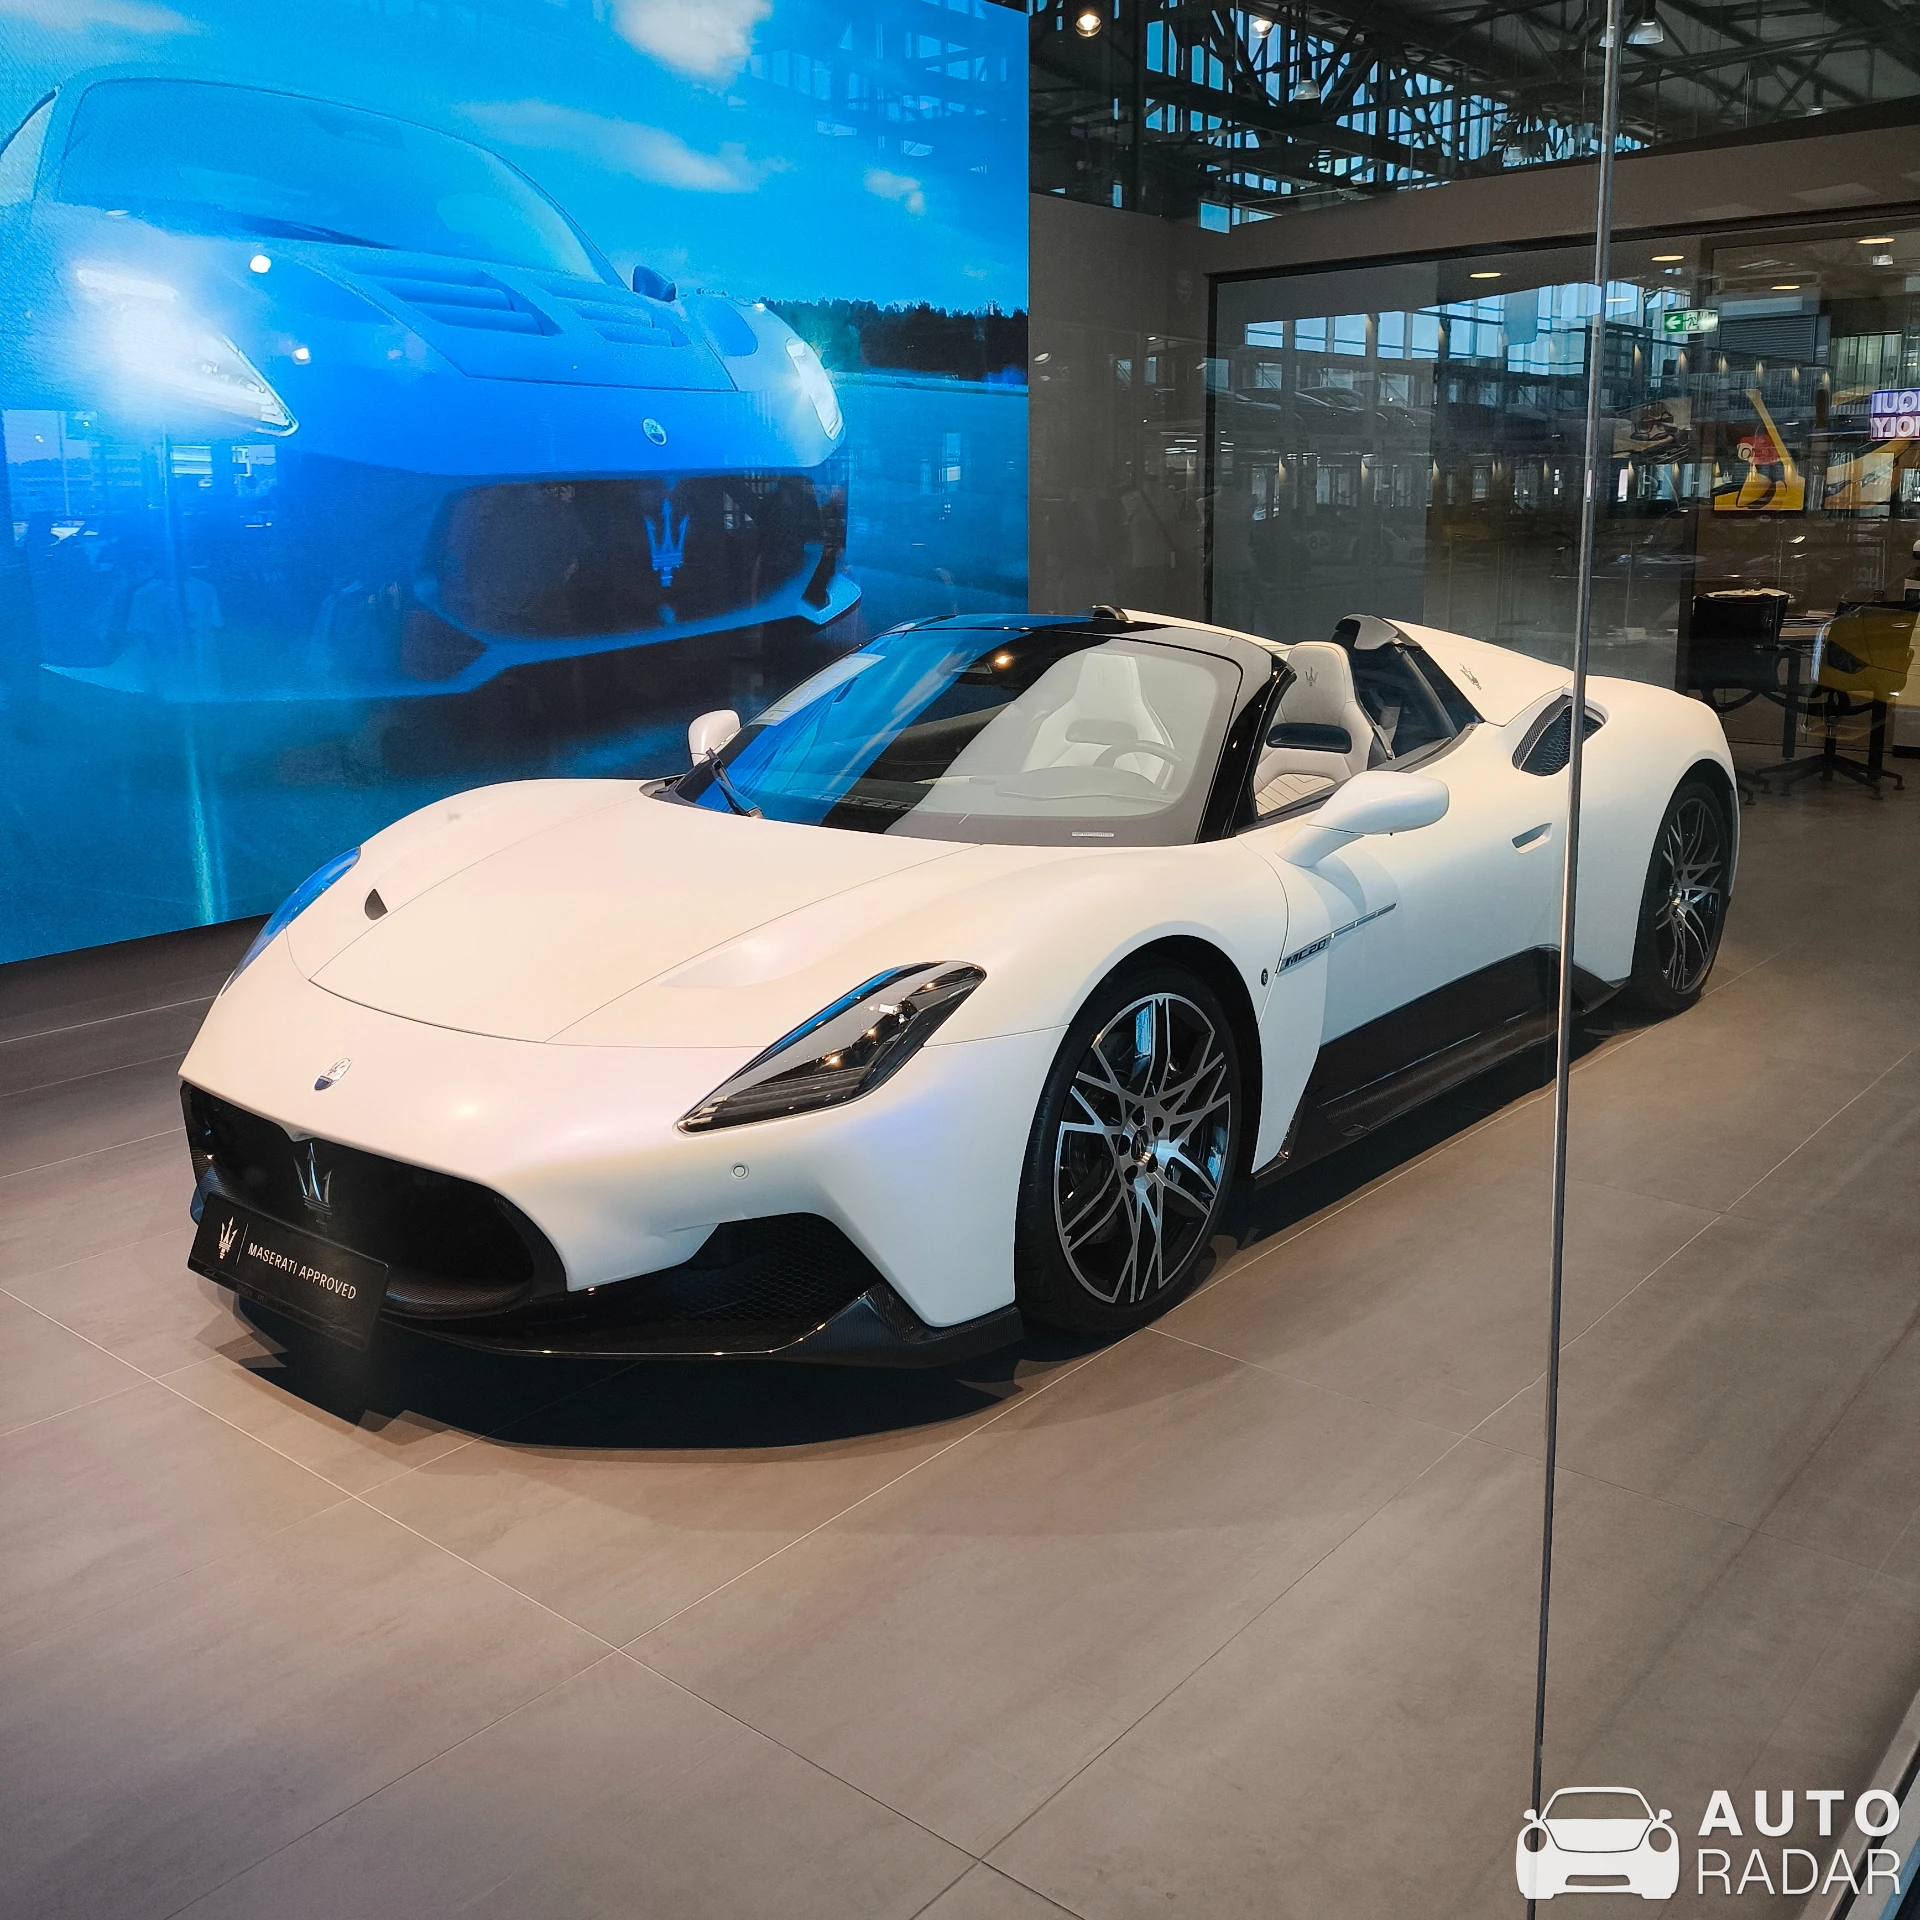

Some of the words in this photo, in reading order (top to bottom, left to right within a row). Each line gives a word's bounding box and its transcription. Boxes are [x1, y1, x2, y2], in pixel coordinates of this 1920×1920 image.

[1285, 939, 1327, 968] MC20
[248, 1242, 298, 1274] MASERATI
[298, 1265, 357, 1300] APPROVED
